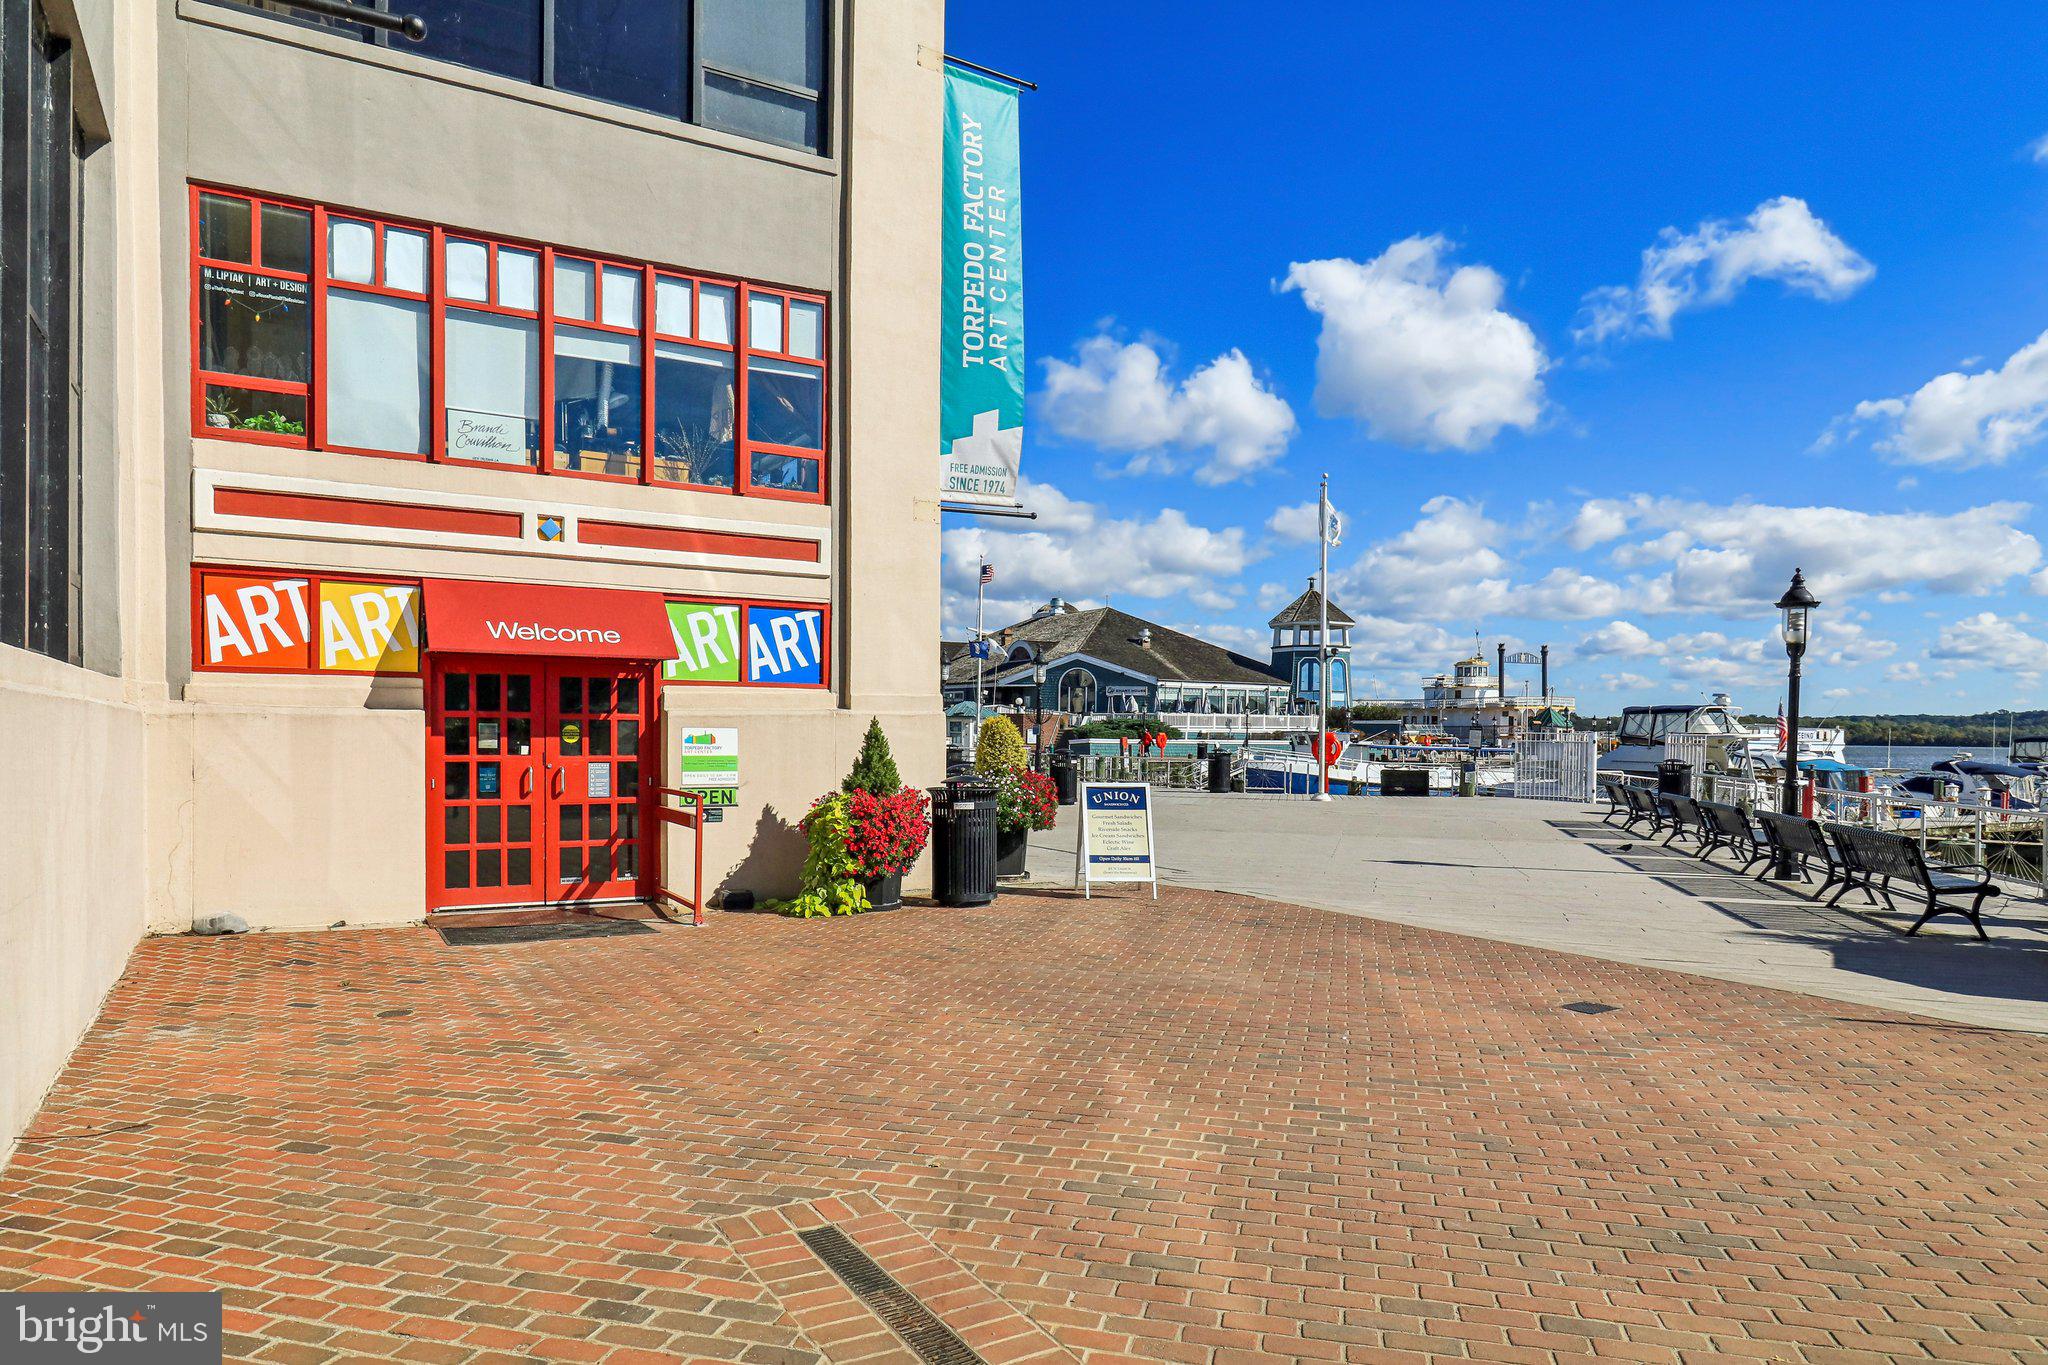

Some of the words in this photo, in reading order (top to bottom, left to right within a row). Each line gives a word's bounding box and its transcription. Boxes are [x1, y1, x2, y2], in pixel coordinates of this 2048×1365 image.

[962, 112, 984, 233] FACTORY
[988, 185, 1007, 302] CENTER
[204, 268, 214, 279] M.
[216, 270, 244, 284] LIPTAK
[255, 277, 271, 288] ART
[280, 281, 308, 294] DESIGN
[962, 242, 984, 367] TORPEDO
[988, 313, 1008, 372] ART
[949, 476, 980, 492] SINCE
[982, 479, 1006, 494] 1974
[950, 462, 968, 474] FREE
[970, 464, 1008, 477] ADMISSION
[206, 578, 311, 663] ART
[321, 586, 419, 668] ART
[485, 620, 621, 644] Welcome
[667, 606, 740, 678] ART
[749, 610, 821, 681] ART
[684, 789, 733, 804] OPEN
[1092, 791, 1140, 804] UNION
